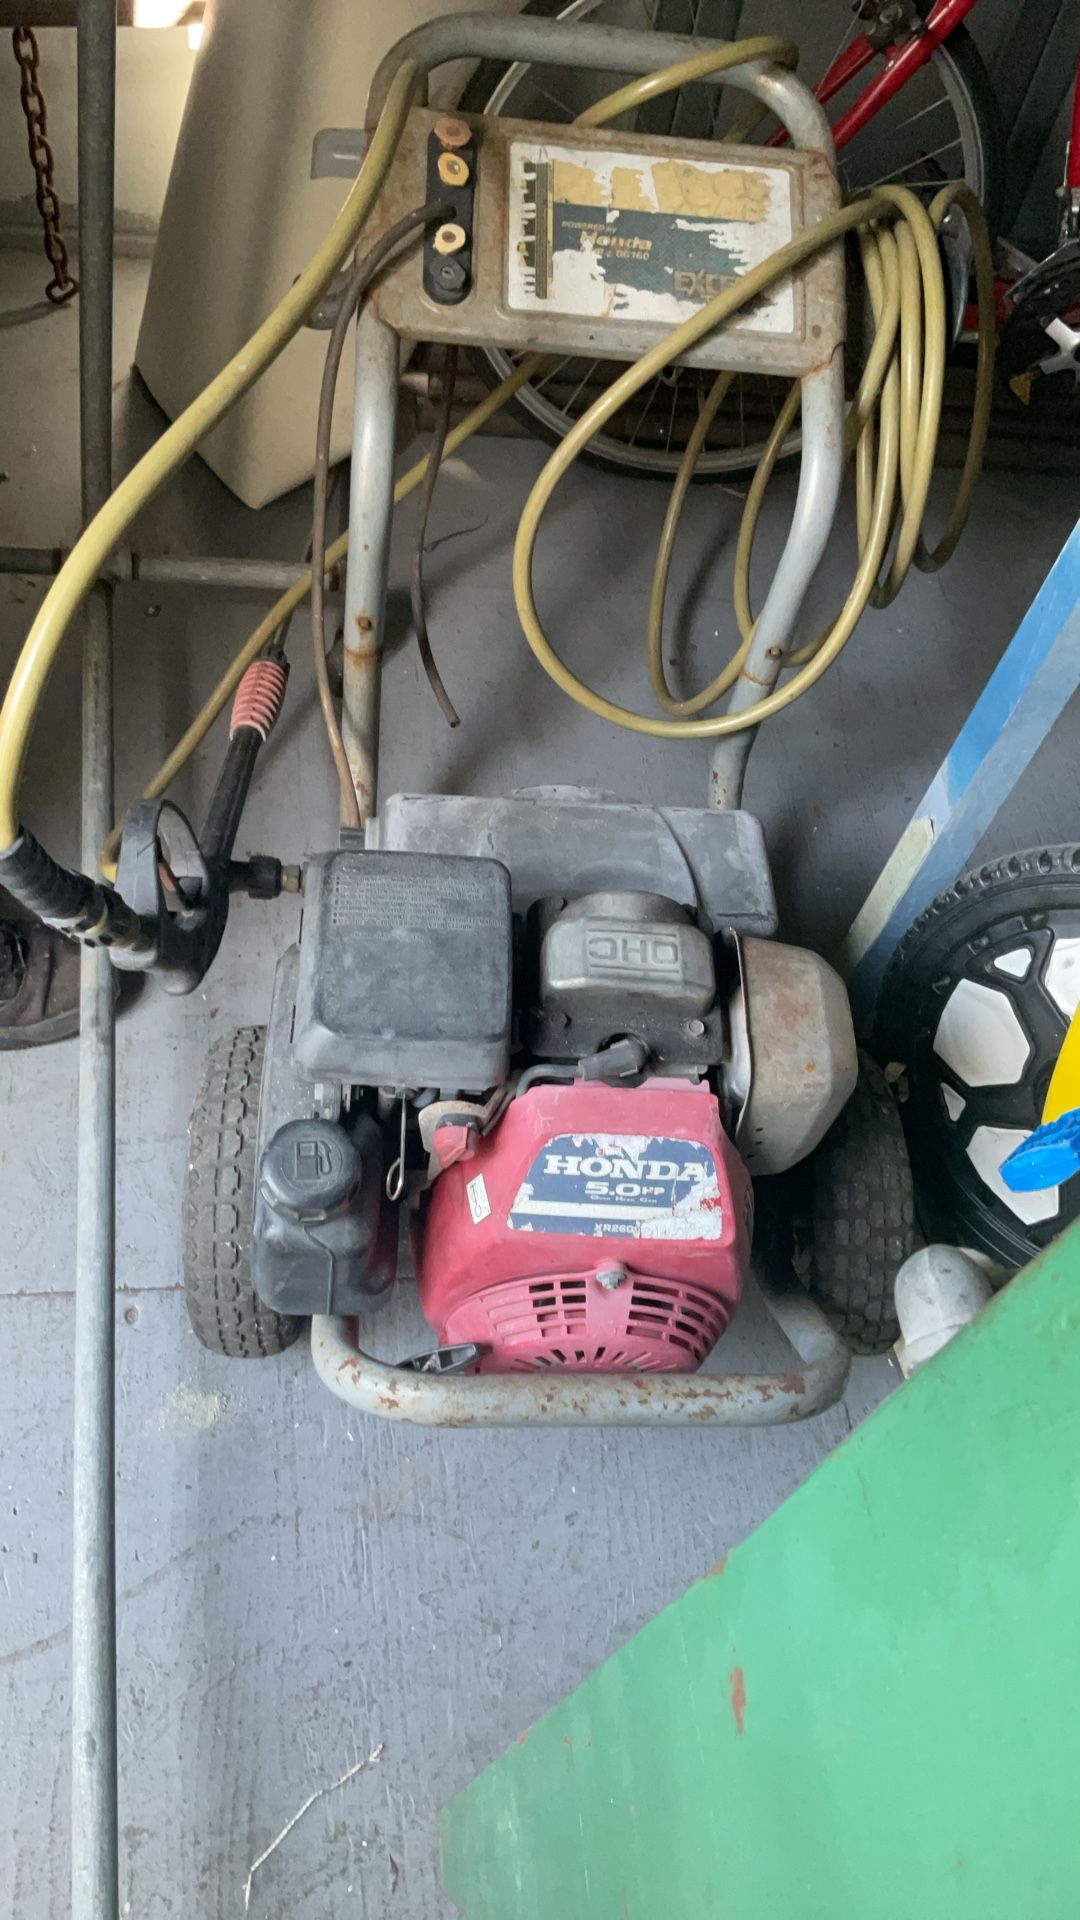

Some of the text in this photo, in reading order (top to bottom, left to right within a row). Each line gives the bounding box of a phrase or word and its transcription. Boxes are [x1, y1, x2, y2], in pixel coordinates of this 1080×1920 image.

[561, 220, 605, 232] POWERED
[587, 935, 679, 966] OHC
[544, 1154, 706, 1182] HONDA
